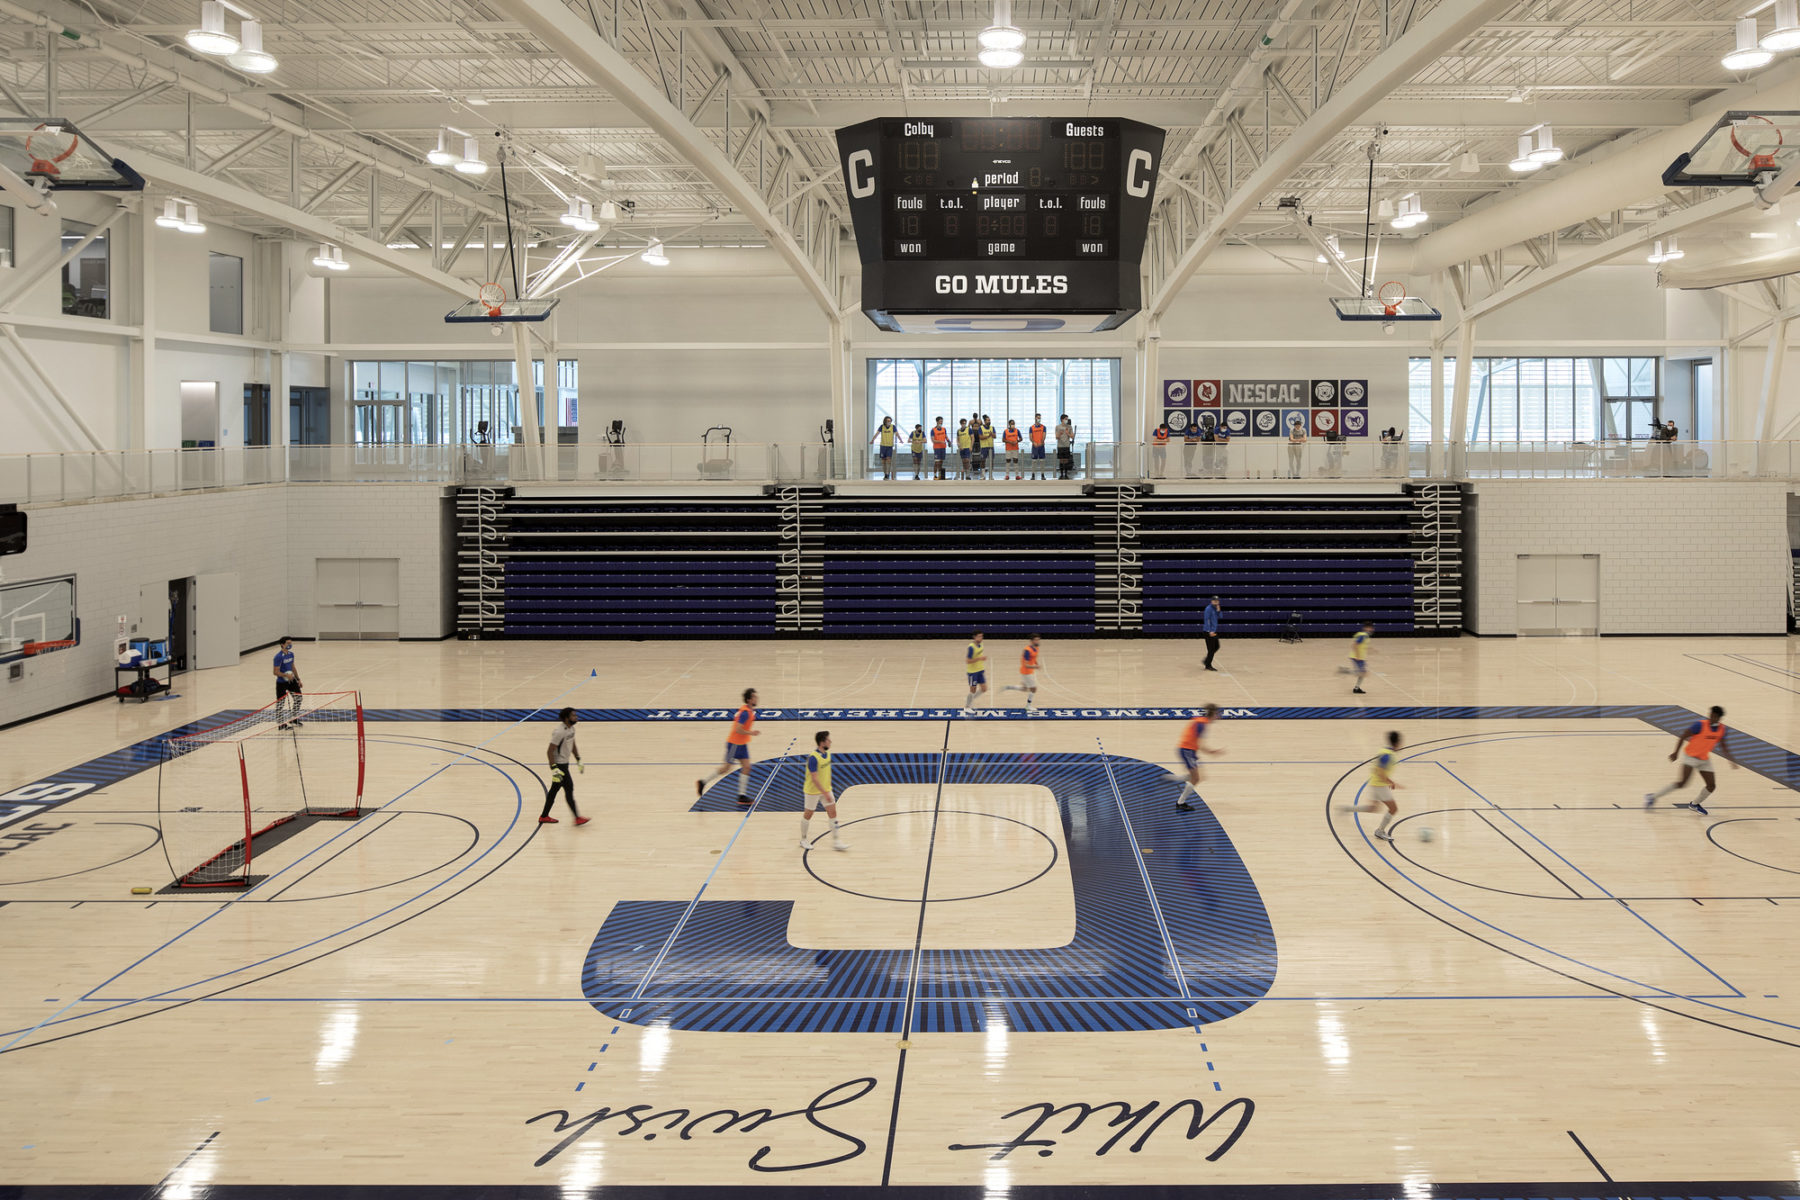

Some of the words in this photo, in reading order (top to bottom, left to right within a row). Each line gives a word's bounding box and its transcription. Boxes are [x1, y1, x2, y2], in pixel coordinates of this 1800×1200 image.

[904, 122, 934, 138] Colby
[1066, 123, 1104, 137] Guests
[848, 149, 876, 199] C
[984, 172, 1019, 187] period
[1126, 148, 1152, 198] C
[897, 197, 923, 210] fouls
[983, 196, 1020, 210] player
[1080, 197, 1106, 210] fouls
[900, 242, 922, 254] won
[987, 242, 1016, 256] game
[1082, 242, 1103, 254] won
[935, 275, 968, 295] GO
[975, 275, 1069, 294] MULES
[1228, 383, 1301, 404] NESCAC
[647, 709, 783, 719] CURT
[525, 1077, 878, 1173] Swish
[948, 1097, 1256, 1163] Whit
